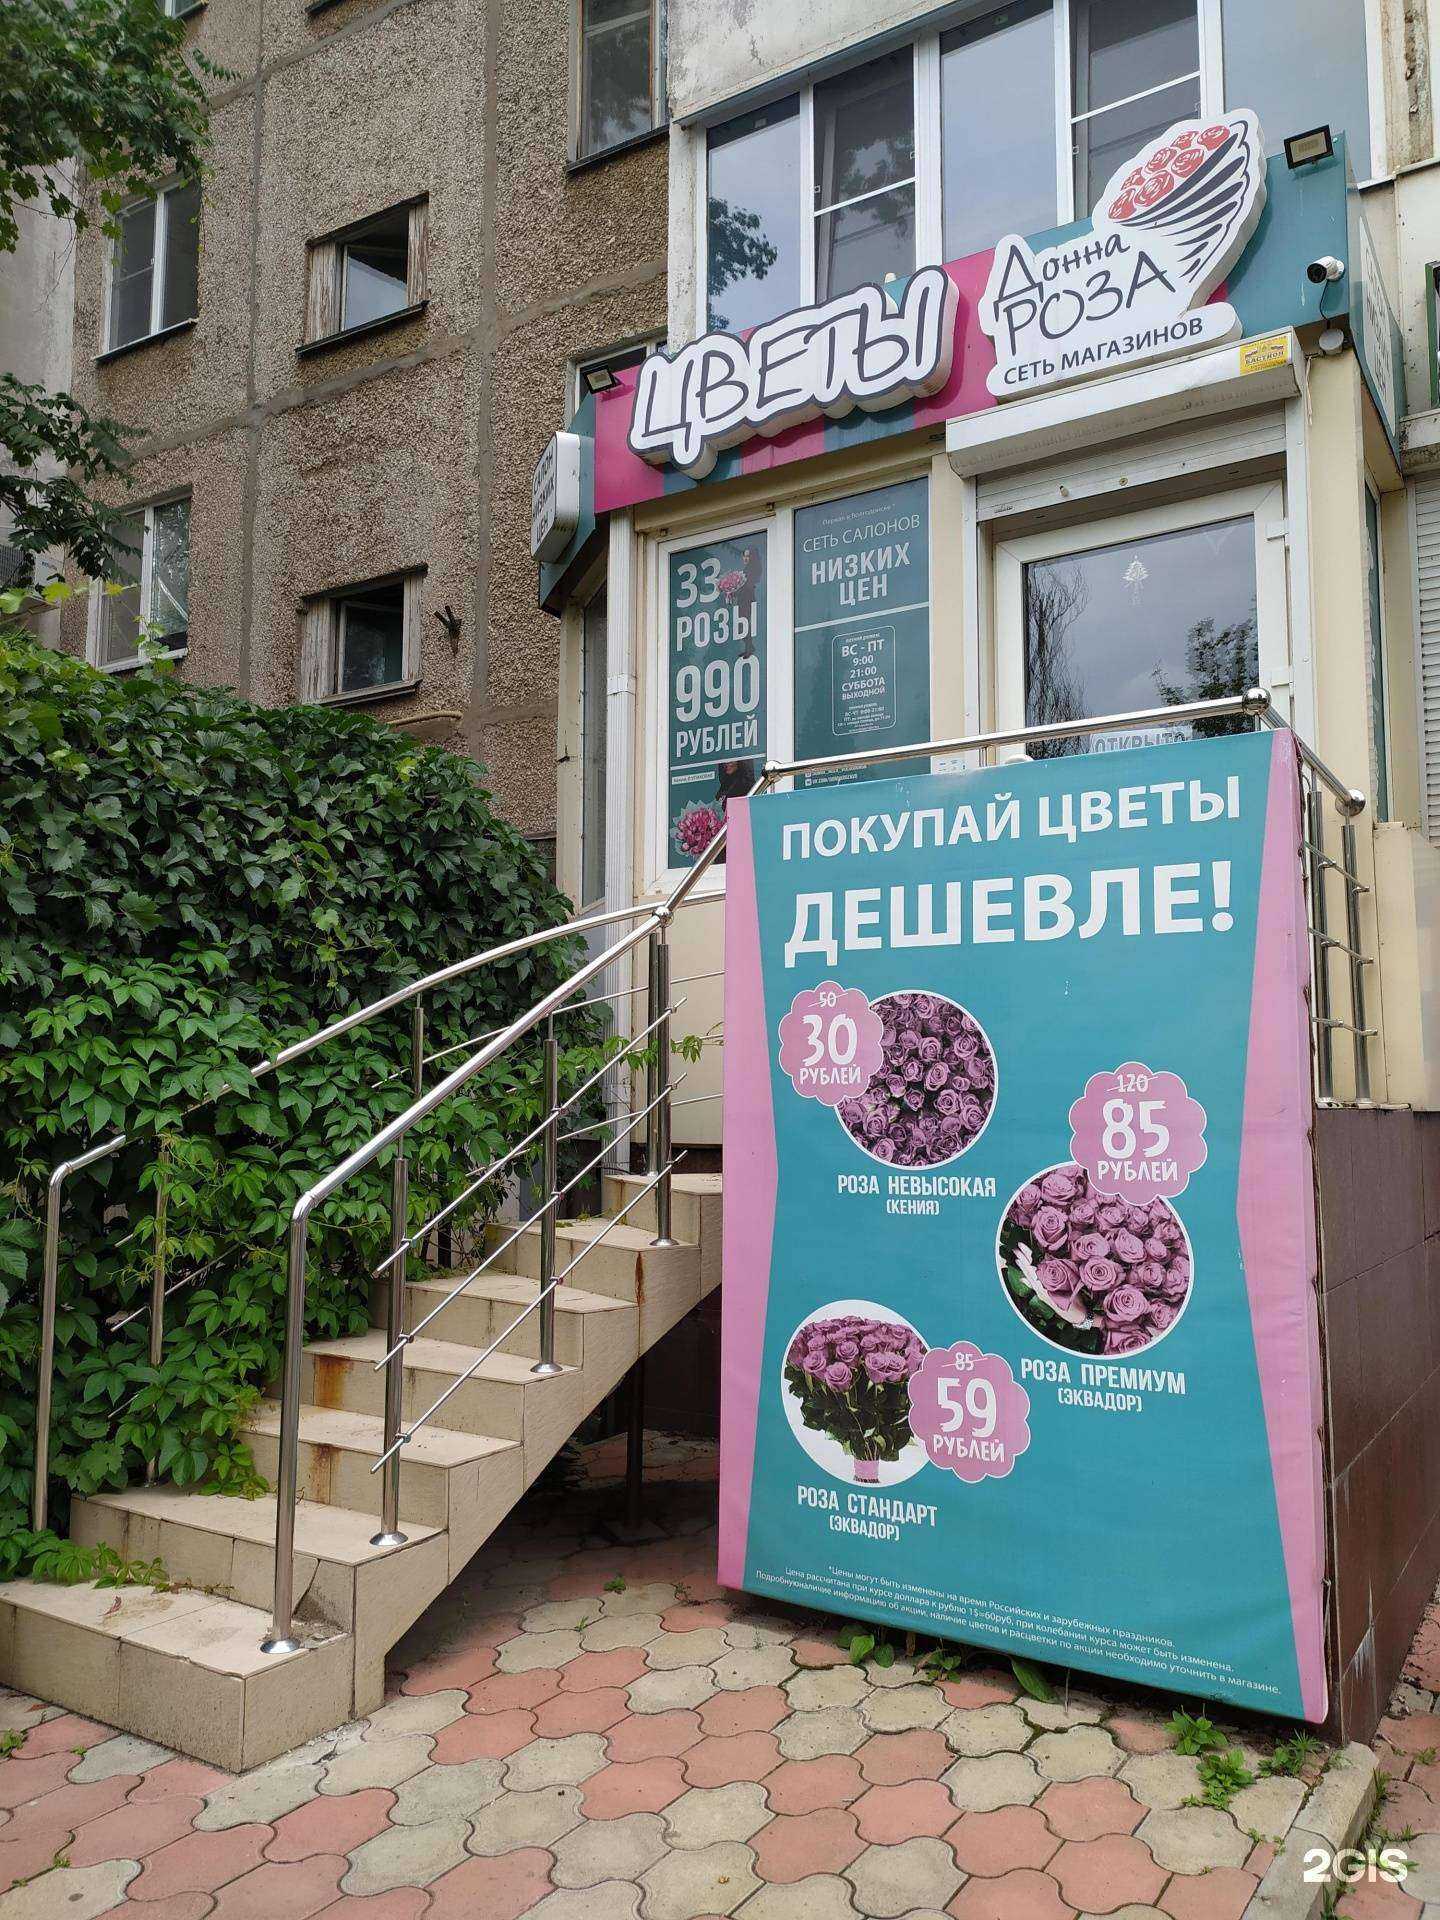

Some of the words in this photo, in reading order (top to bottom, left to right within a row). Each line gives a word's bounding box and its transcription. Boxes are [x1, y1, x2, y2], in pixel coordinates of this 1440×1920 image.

[993, 233, 1130, 322] Донна
[1003, 251, 1176, 355] РОЗА
[629, 267, 947, 469] ЦВЕТЫ
[1004, 359, 1055, 385] СЕТЬ
[1061, 318, 1203, 371] МАГАЗИНОВ
[803, 533, 839, 553] СЕТЬ
[842, 514, 920, 544] САЛОНОВ
[677, 557, 721, 609] 33
[812, 542, 911, 585] НИЗКИХ
[840, 573, 888, 606] ЦЕН
[676, 601, 757, 652] РОЗЫ
[841, 644, 858, 657] ВС
[867, 639, 885, 652] ПТ
[853, 655, 874, 666] 9:00
[676, 654, 760, 723] 990
[842, 677, 886, 691] СУББОТА
[850, 666, 877, 678] 21:00
[842, 686, 886, 700] ВЫХОДНОЙ
[676, 714, 758, 758] РУБЛЕЙ
[781, 792, 1020, 861] ПОКУПАЙ
[1038, 775, 1240, 842] ЦВЕТЫ
[783, 860, 1235, 968] ДЕШЕВЛЕ!
[818, 992, 837, 1007] 50
[801, 1013, 856, 1067] 30
[799, 1064, 862, 1086] РУБЛЕЙ
[1117, 1073, 1149, 1092] 120
[1101, 1098, 1171, 1160] 85
[837, 1175, 880, 1195] РОЗА
[888, 1175, 996, 1198] НЕВЫСОКАЯ
[1096, 1157, 1179, 1183] РУБЛЕЙ
[886, 1198, 940, 1216] (КЕНИЯ)
[955, 1351, 975, 1371] 85
[1020, 1357, 1072, 1384] РОЗА
[1080, 1363, 1186, 1395] ПРЕМИУМ
[936, 1377, 998, 1438] 59
[1057, 1387, 1142, 1413] (ЭКВАДОР)
[932, 1435, 1005, 1463] РУБЛЕЙ
[797, 1485, 840, 1512] РОЗА
[847, 1493, 937, 1527] СТАНДАРТ
[829, 1514, 900, 1542] (ЭКВАДОР)
[785, 1567, 805, 1579] Цена
[806, 1573, 850, 1588] рассчитана
[852, 1583, 868, 1594] при
[869, 1586, 893, 1600] курсе
[894, 1592, 930, 1607] доллара
[938, 1602, 967, 1616] рублю
[1016, 1619, 1034, 1631] при
[1035, 1622, 1087, 1641] колебании
[1089, 1635, 1117, 1649] курса
[1119, 1642, 1152, 1654] может
[1153, 1647, 1179, 1661] быть
[1180, 1654, 1234, 1673] изменена.
[855, 1573, 879, 1588] могут
[880, 1577, 900, 1589] быть
[902, 1583, 945, 1599] изменены
[947, 1592, 958, 1601] на
[960, 1595, 987, 1609] время
[988, 1601, 1042, 1620] Российских
[1051, 1616, 1110, 1634] зарубежных
[1112, 1628, 1176, 1648] праздников.
[833, 1587, 887, 1608] информацию
[888, 1600, 899, 1610] об
[930, 1612, 967, 1626] наличие
[968, 1620, 1000, 1634] цветов
[1009, 1629, 1058, 1647] расцветки
[1060, 1639, 1072, 1649] по
[1073, 1643, 1103, 1656] акции
[1105, 1650, 1167, 1670] необходимо
[1169, 1662, 1217, 1681] уточнить
[1227, 1675, 1282, 1695] магазине.
